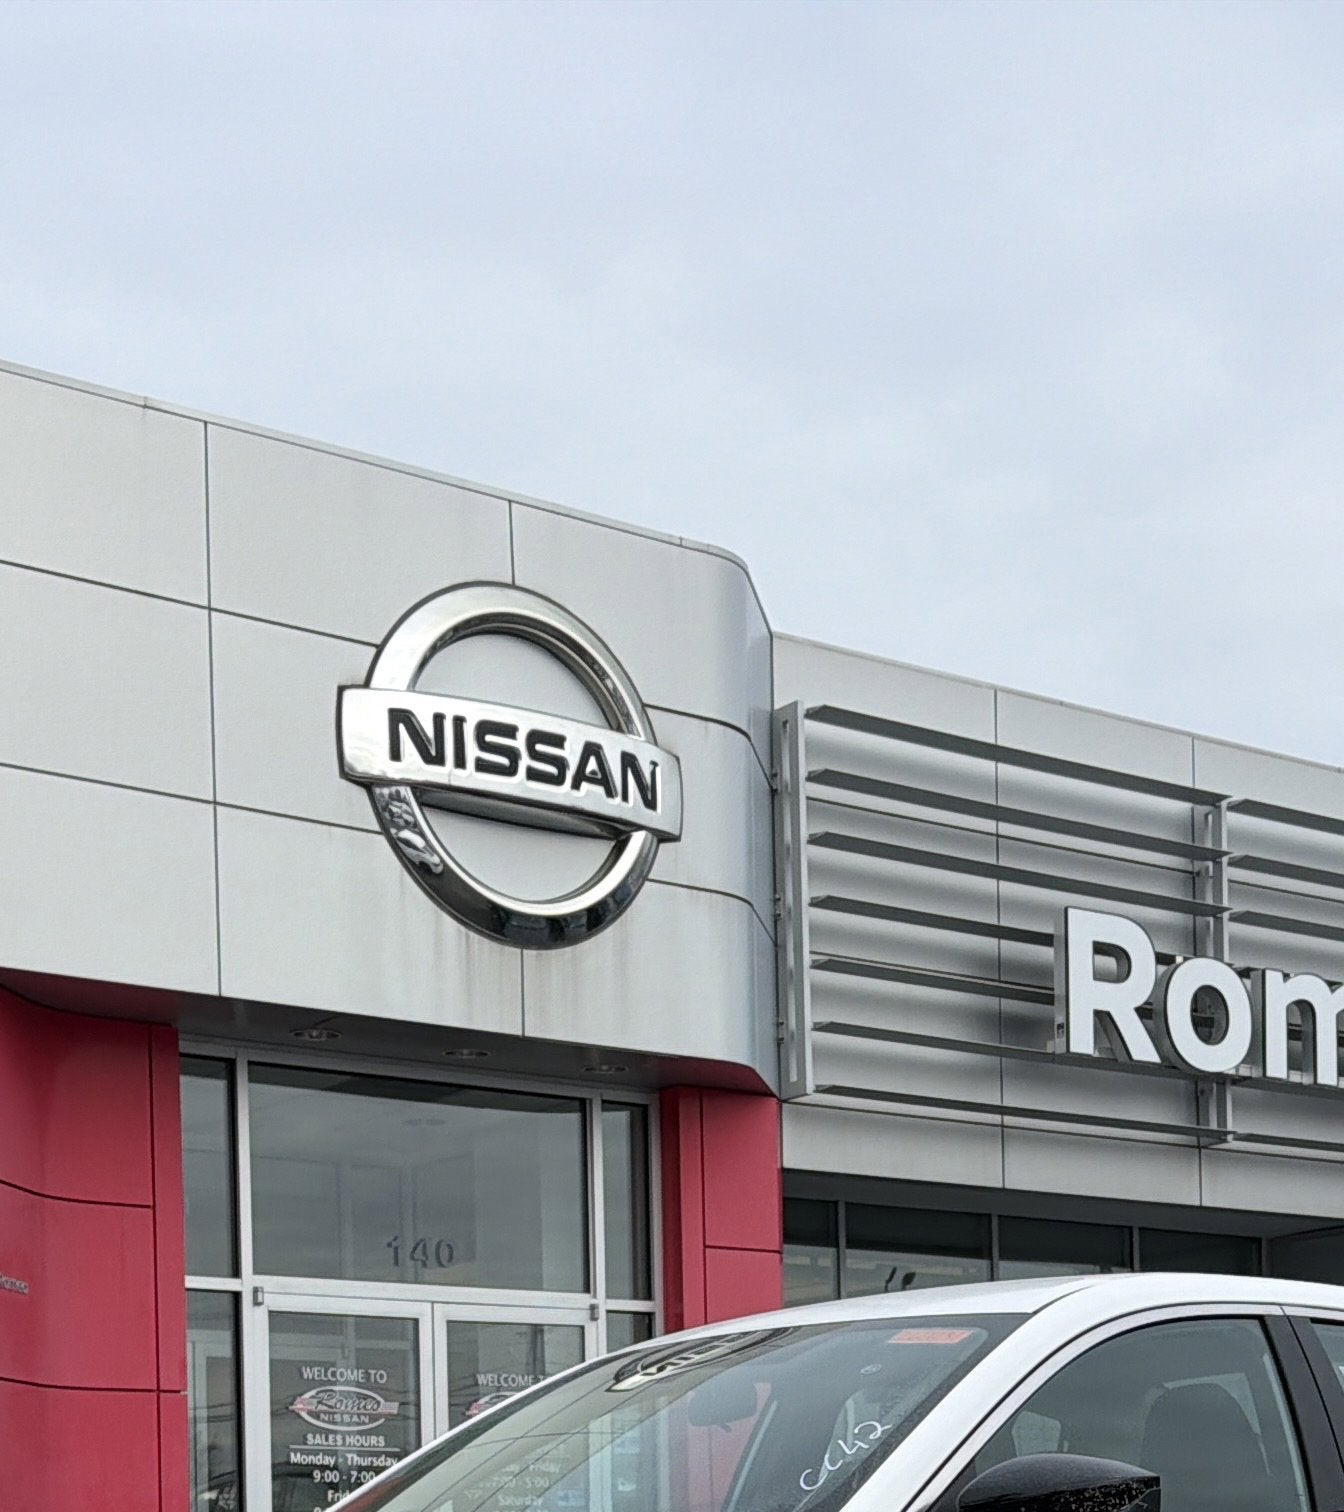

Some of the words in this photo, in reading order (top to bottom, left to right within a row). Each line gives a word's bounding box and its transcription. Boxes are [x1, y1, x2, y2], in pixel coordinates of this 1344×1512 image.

[387, 706, 662, 814] NISSAN
[386, 1235, 455, 1268] 140
[301, 1366, 366, 1383] WELCOME
[368, 1369, 387, 1384] TO
[476, 1373, 534, 1387] WELCOME
[315, 1390, 381, 1412] Romeo
[319, 1412, 370, 1424] NISSAN
[306, 1433, 343, 1446] SALES
[345, 1434, 386, 1447] HOURS
[289, 1452, 336, 1468] Monday
[345, 1453, 398, 1467] Thursday
[312, 1469, 340, 1483] 9:00
[350, 1470, 376, 1483] 7:00
